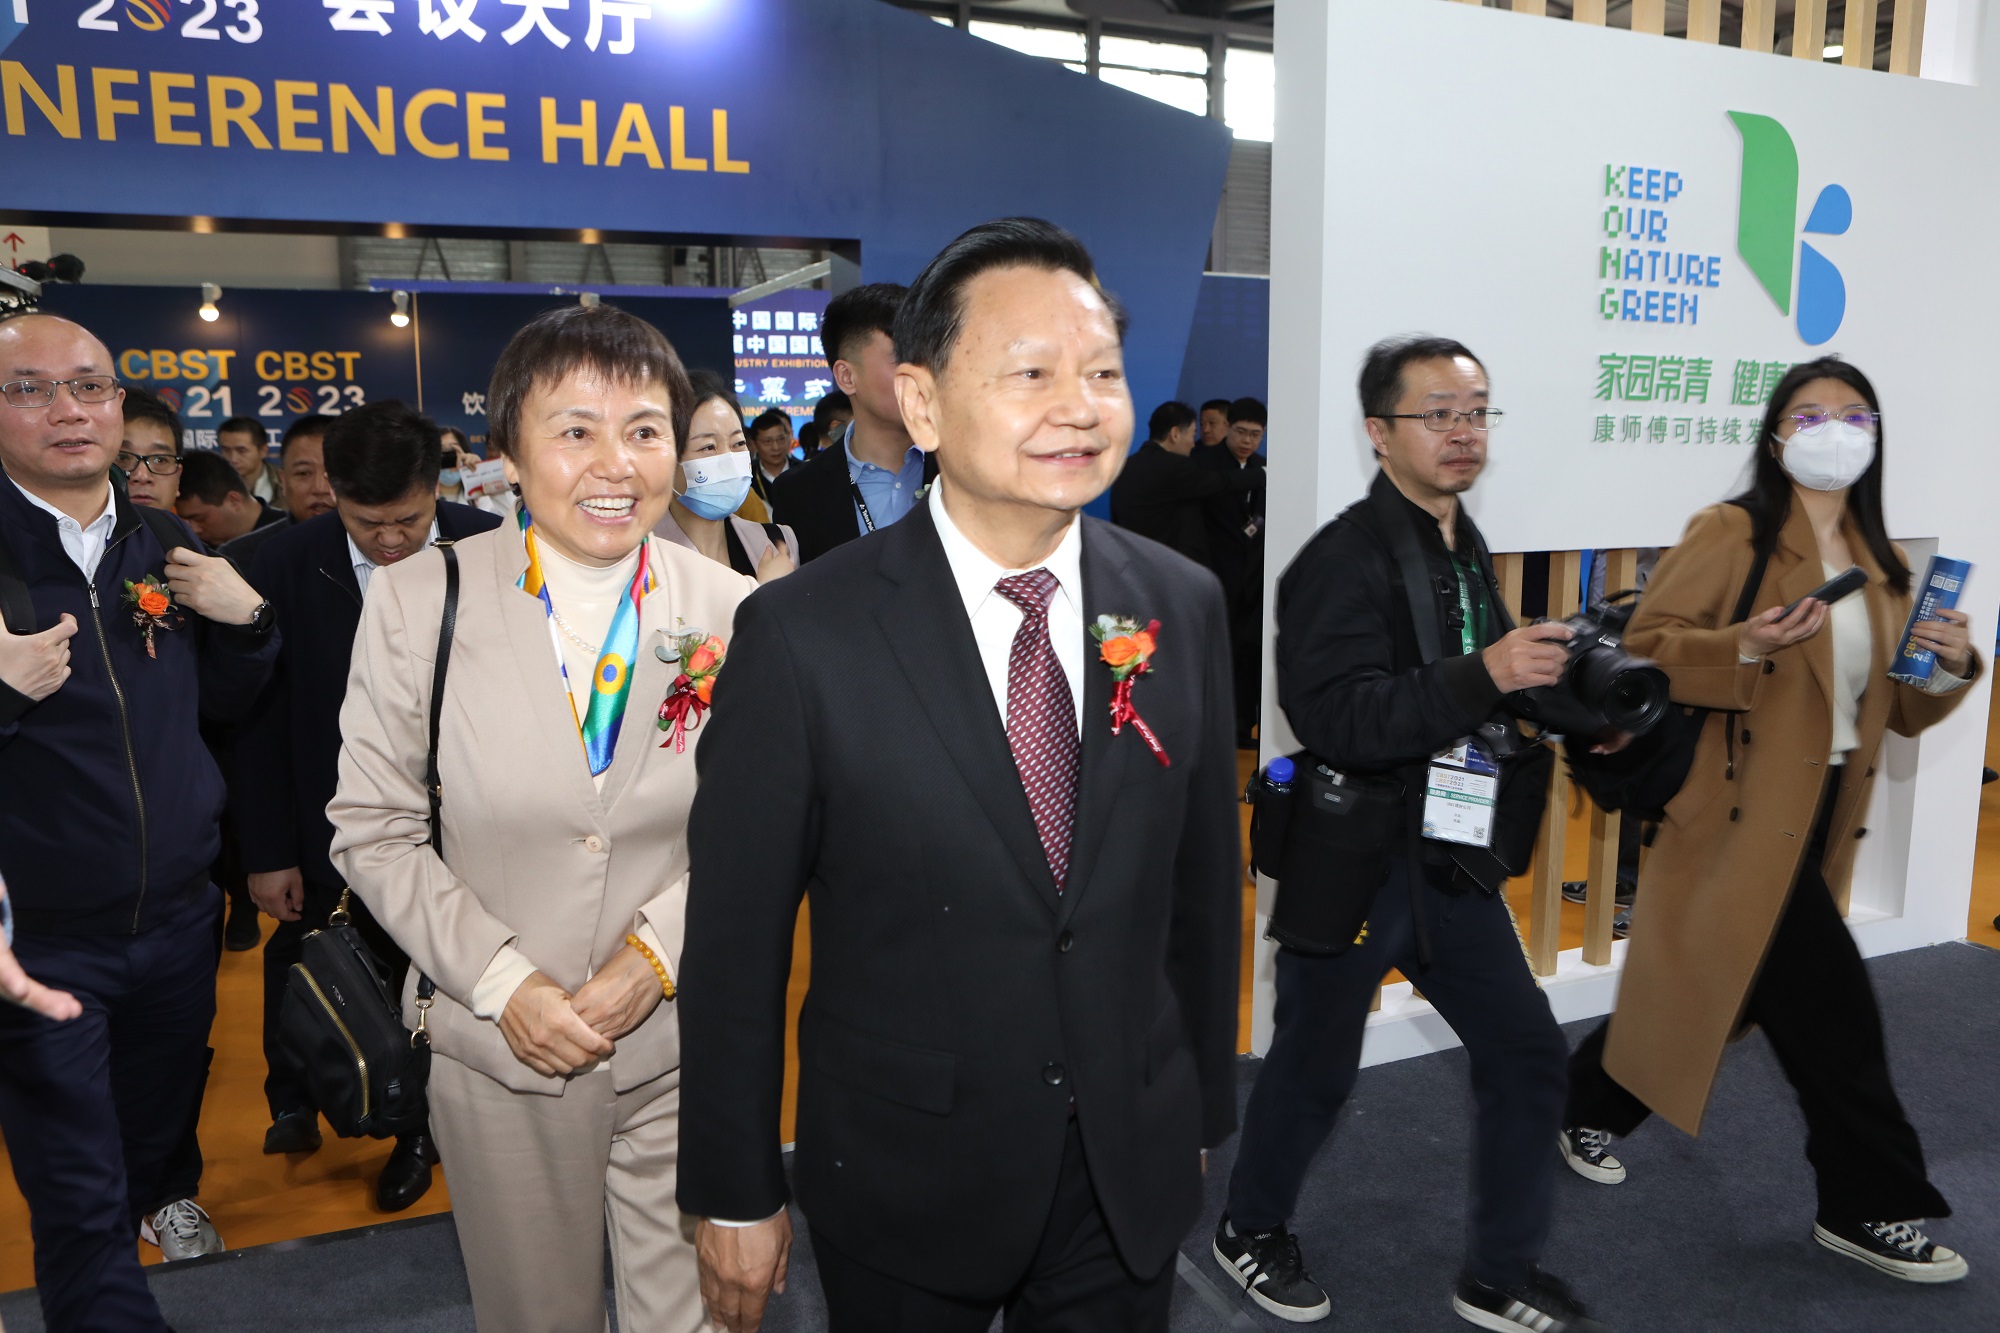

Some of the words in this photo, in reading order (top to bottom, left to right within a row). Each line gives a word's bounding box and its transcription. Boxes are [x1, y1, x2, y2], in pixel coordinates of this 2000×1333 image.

[322, 0, 652, 55] 会议大厅
[0, 60, 510, 161] NFERENCE
[540, 96, 750, 174] HALL
[1605, 164, 1683, 203] KEEP
[1603, 205, 1668, 243] OUR
[1601, 246, 1721, 288] NATURE
[732, 309, 826, 331] 中国国际
[1600, 288, 1699, 326] GREEN
[119, 349, 236, 381] CBST
[255, 351, 362, 381] CBST
[1594, 352, 1713, 405] 家园常青
[1731, 359, 1799, 405] 健康
[462, 391, 486, 416] 饮
